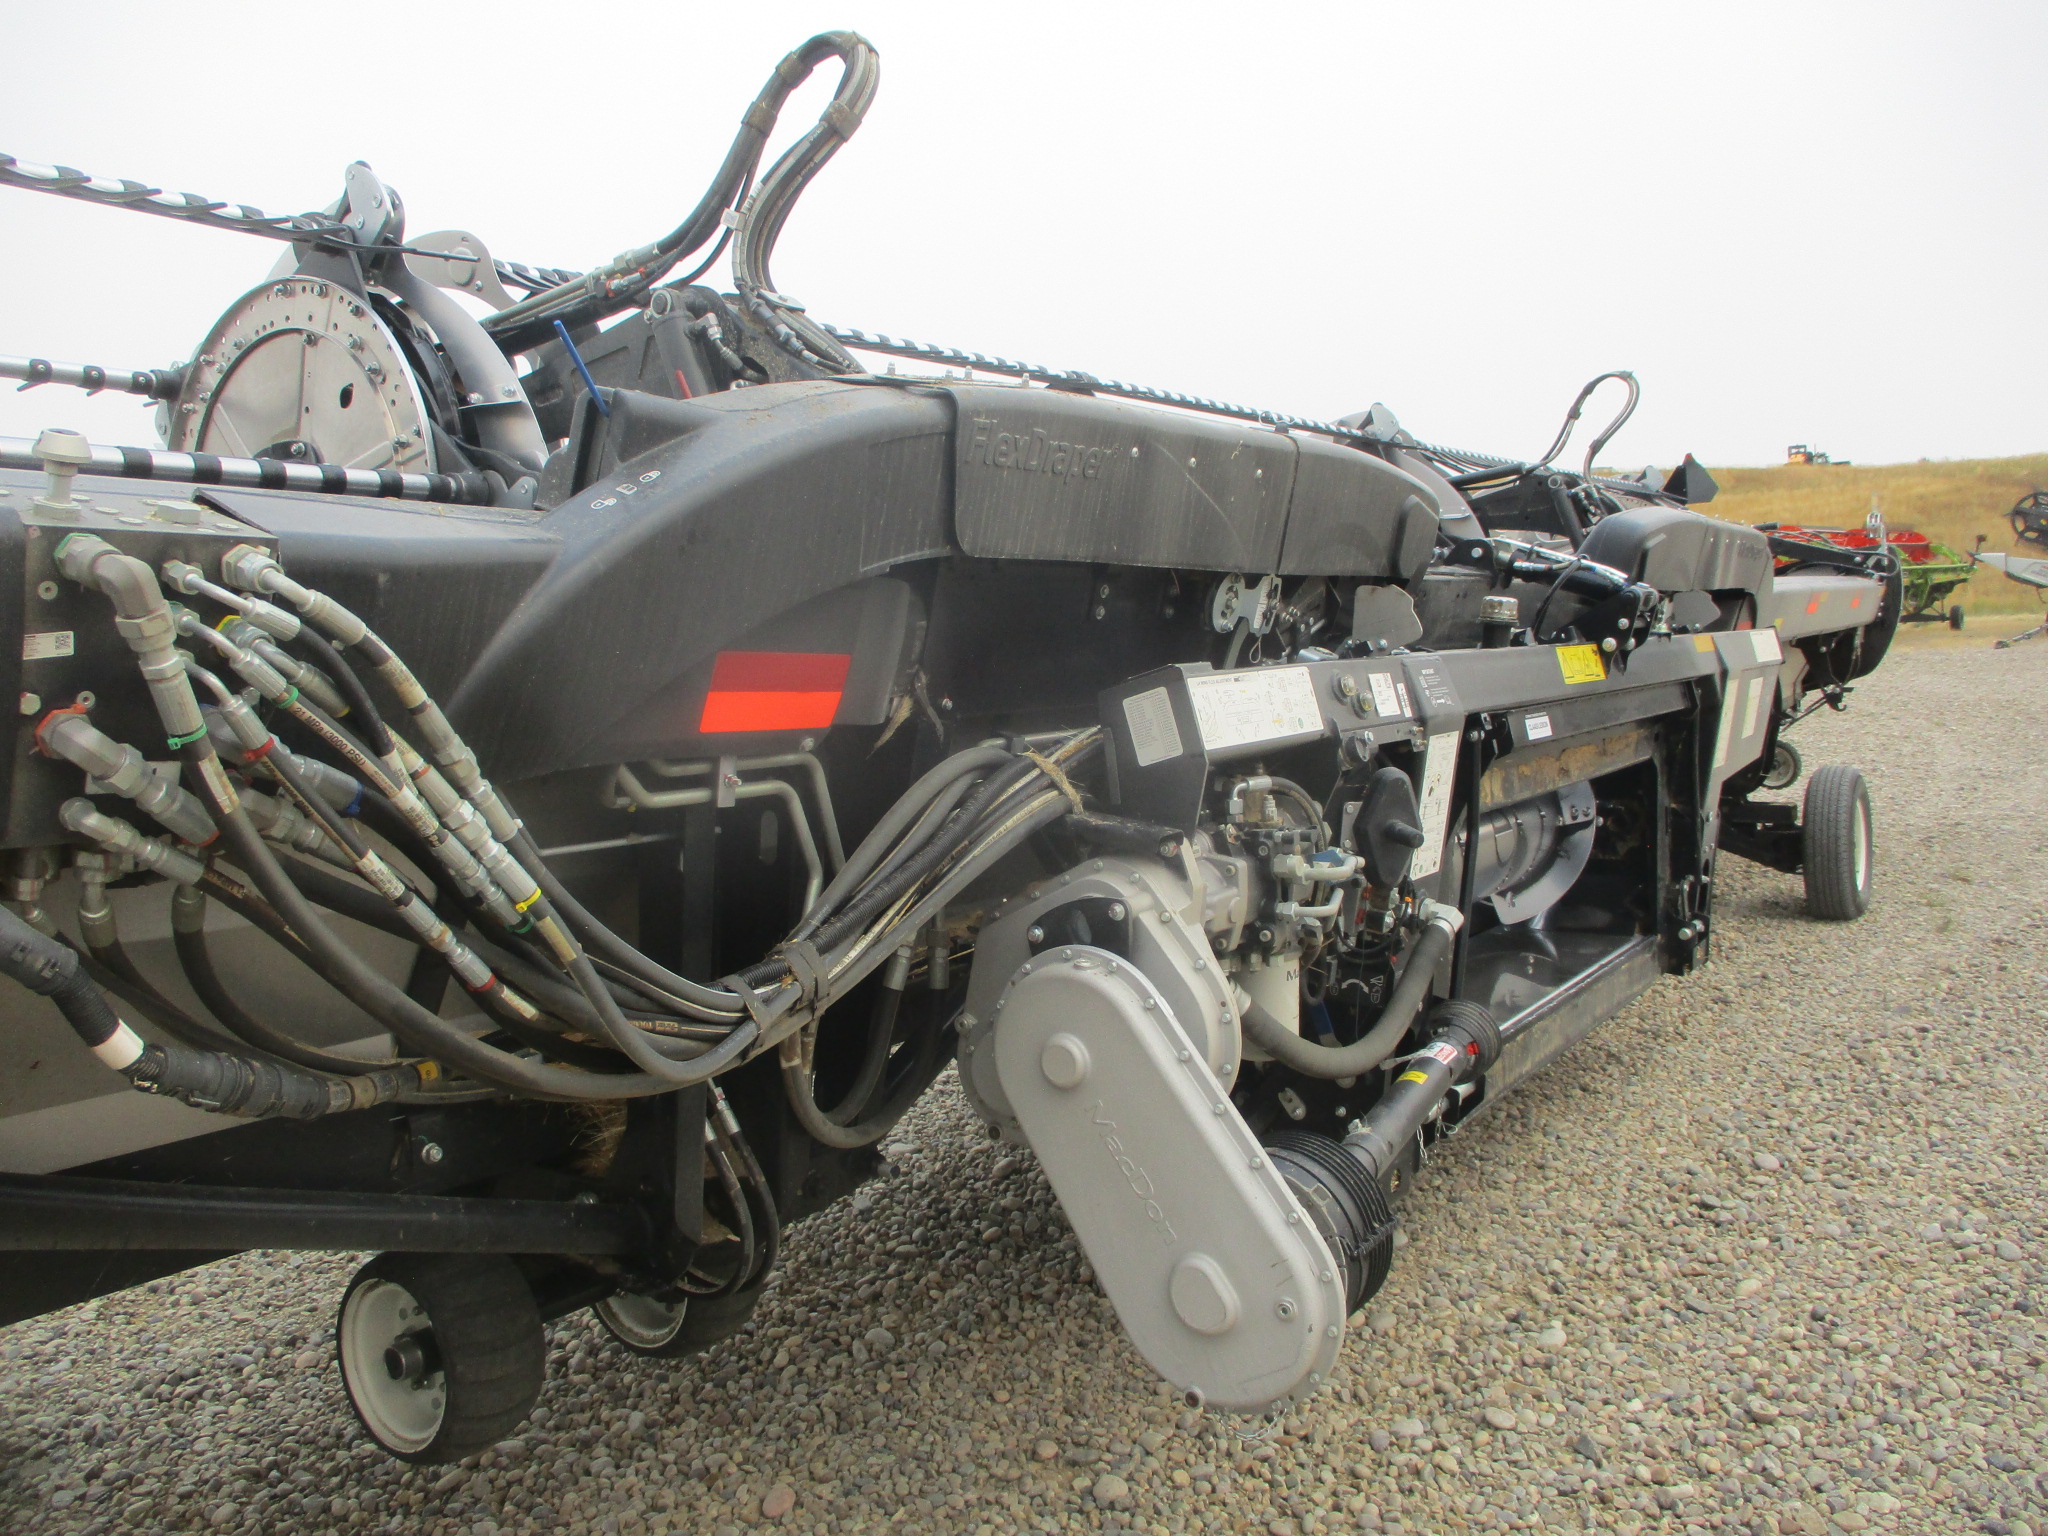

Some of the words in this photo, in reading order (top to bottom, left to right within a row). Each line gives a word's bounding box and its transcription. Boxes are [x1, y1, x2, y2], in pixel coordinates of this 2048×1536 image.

[294, 707, 306, 717] 21
[305, 715, 324, 733] MPa
[324, 730, 348, 752] (3000
[346, 748, 367, 767] PSI)
[1084, 1099, 1177, 1247] MacDon
